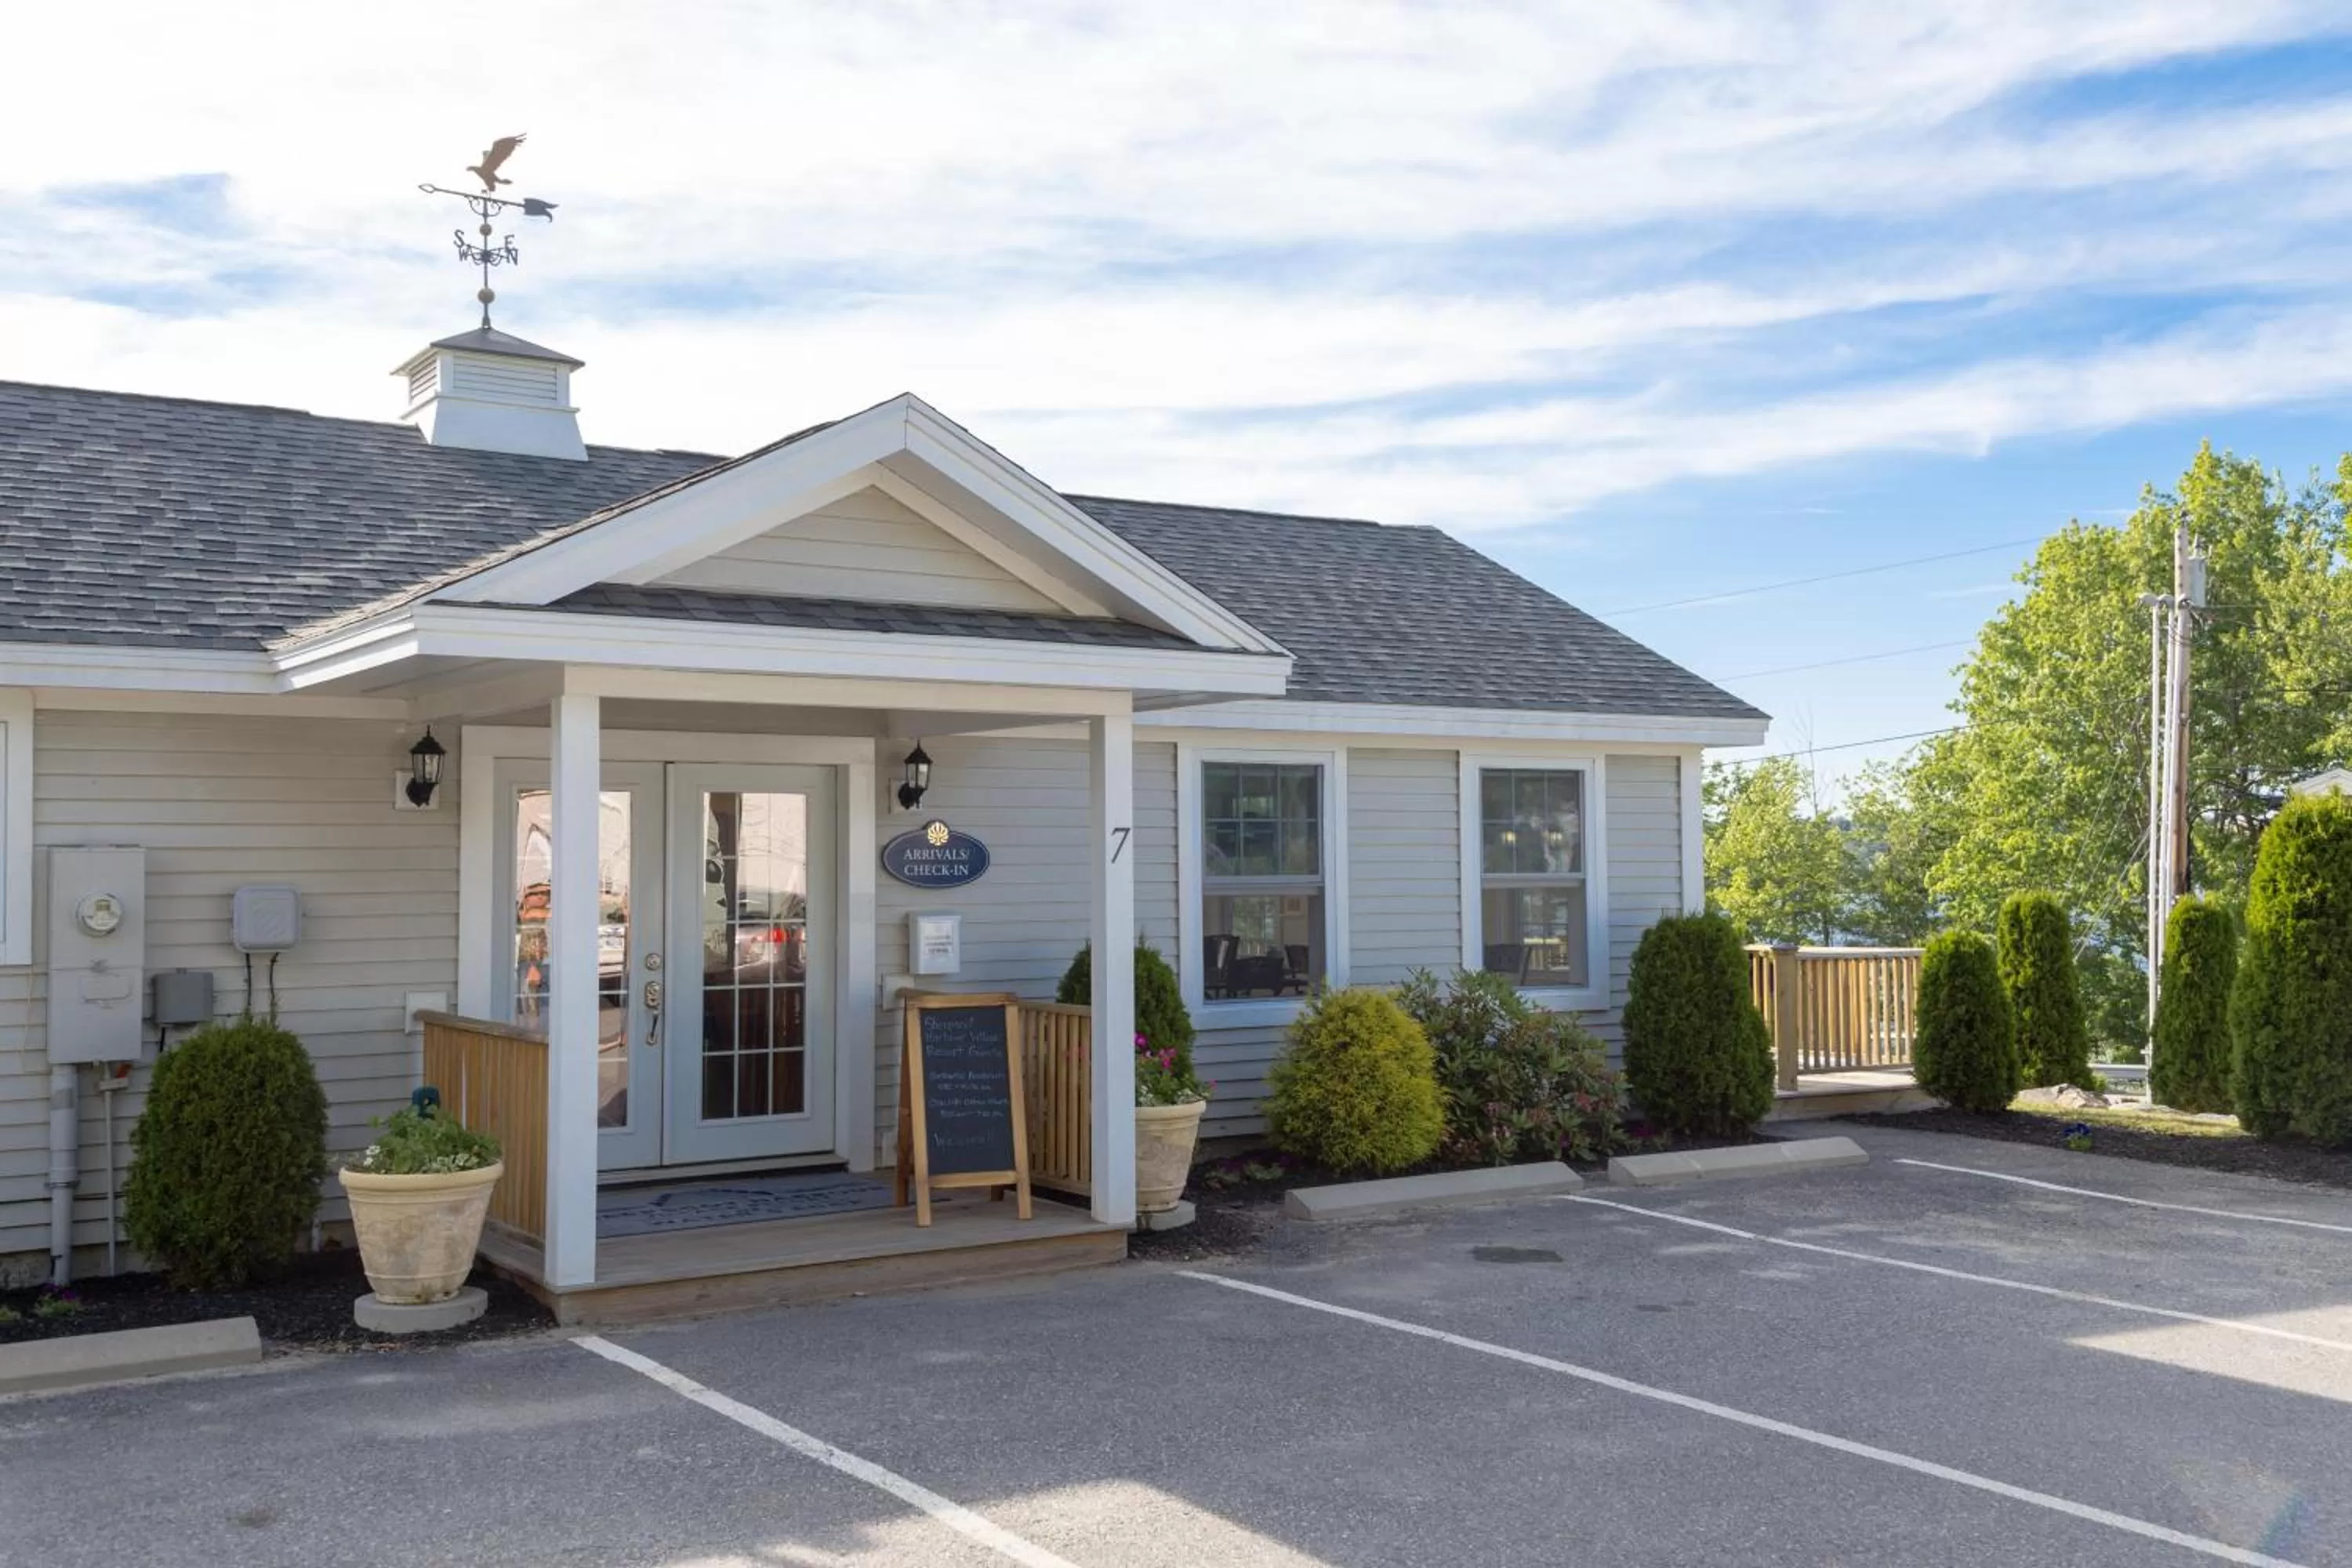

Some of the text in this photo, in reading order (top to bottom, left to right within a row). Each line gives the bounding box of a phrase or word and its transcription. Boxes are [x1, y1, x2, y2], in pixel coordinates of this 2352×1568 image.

[453, 229, 465, 249] S
[505, 234, 515, 252] E
[458, 245, 471, 262] W
[506, 248, 519, 267] N
[1110, 827, 1131, 864] 7
[903, 865, 969, 876] CHECK-IN
